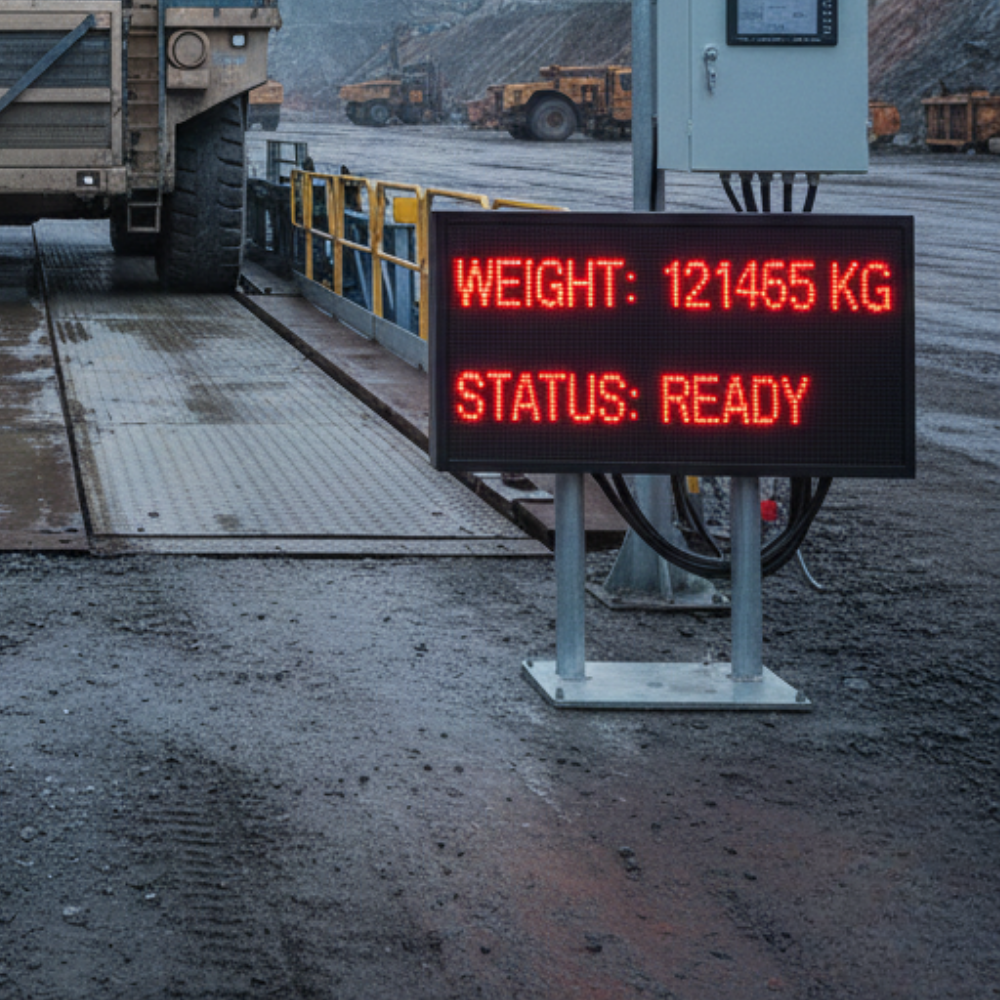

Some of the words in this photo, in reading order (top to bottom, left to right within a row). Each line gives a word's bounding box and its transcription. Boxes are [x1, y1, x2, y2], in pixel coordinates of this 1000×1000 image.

[453, 257, 636, 309] WEIGHT:
[663, 259, 817, 311] 121465
[829, 260, 893, 313] KG
[454, 369, 639, 424] STATUS:
[660, 372, 810, 426] READY
